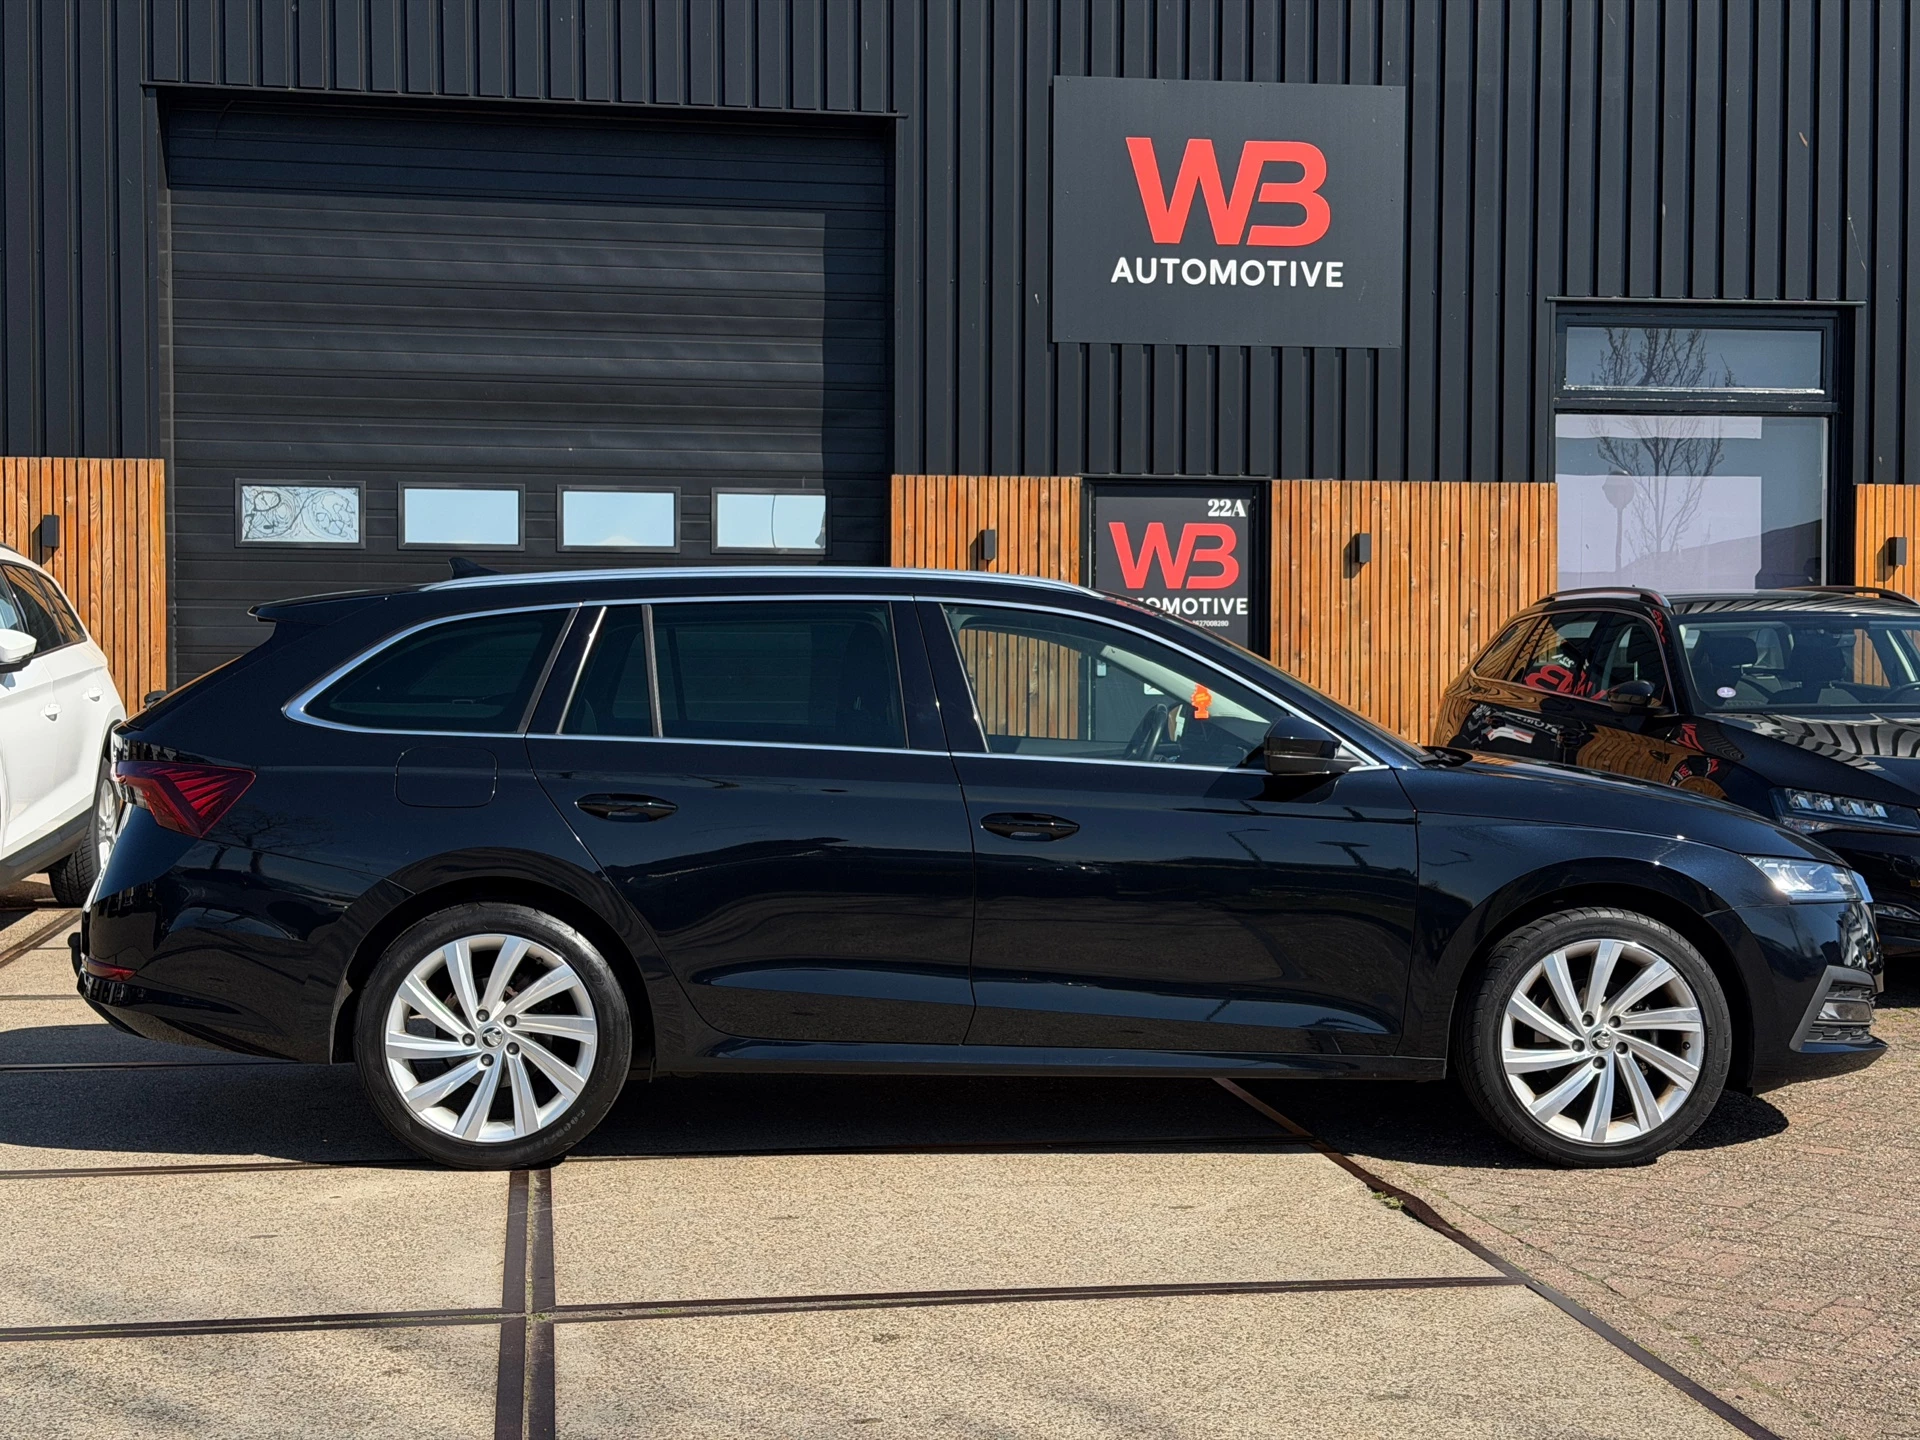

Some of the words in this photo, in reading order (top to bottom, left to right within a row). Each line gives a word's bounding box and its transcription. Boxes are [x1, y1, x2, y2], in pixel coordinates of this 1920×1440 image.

[1125, 136, 1331, 247] WB
[1110, 256, 1344, 288] AUTOMOTIVE
[1207, 498, 1247, 518] 22A
[1108, 521, 1240, 590] WB
[1137, 597, 1249, 615] OMOTIVE
